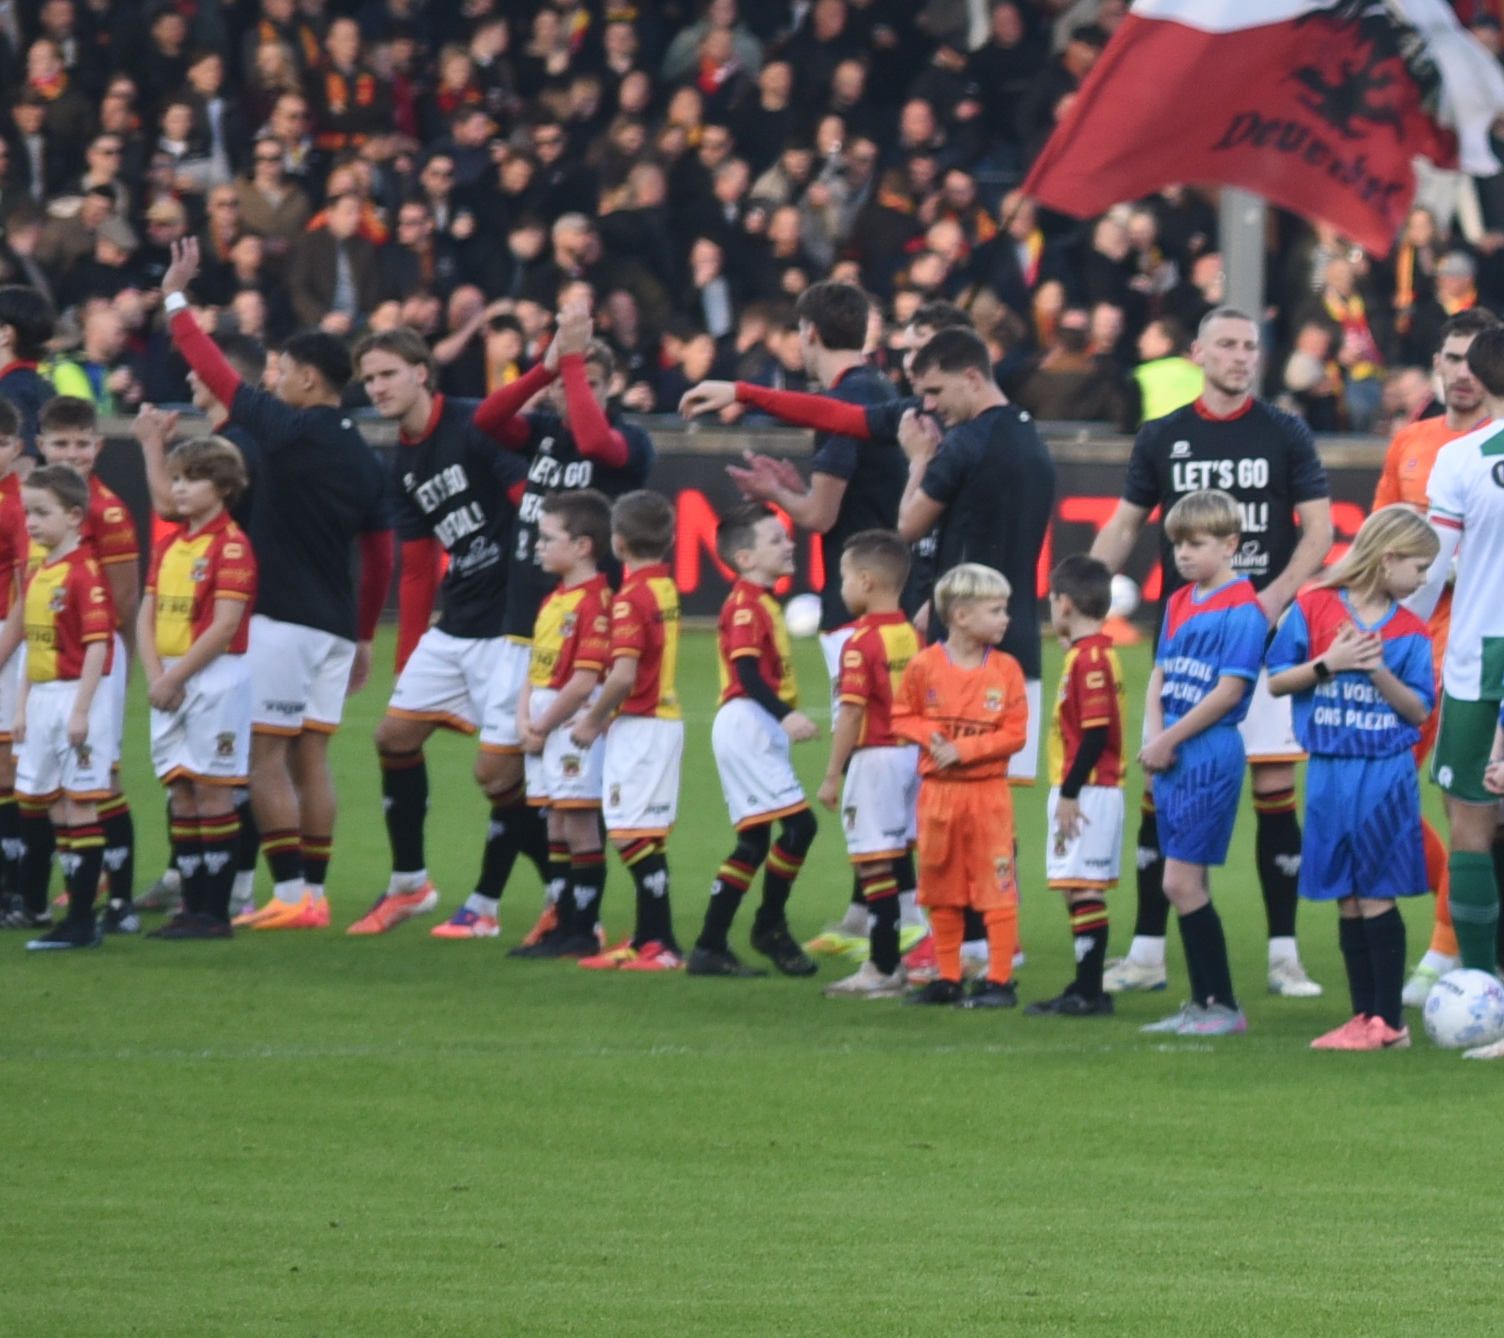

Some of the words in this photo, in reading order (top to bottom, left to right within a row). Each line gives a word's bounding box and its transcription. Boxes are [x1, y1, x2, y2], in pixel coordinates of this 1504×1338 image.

[563, 460, 593, 489] GO
[1172, 459, 1235, 493] LET'S
[1237, 457, 1269, 489] GO
[1314, 705, 1342, 727] ONS
